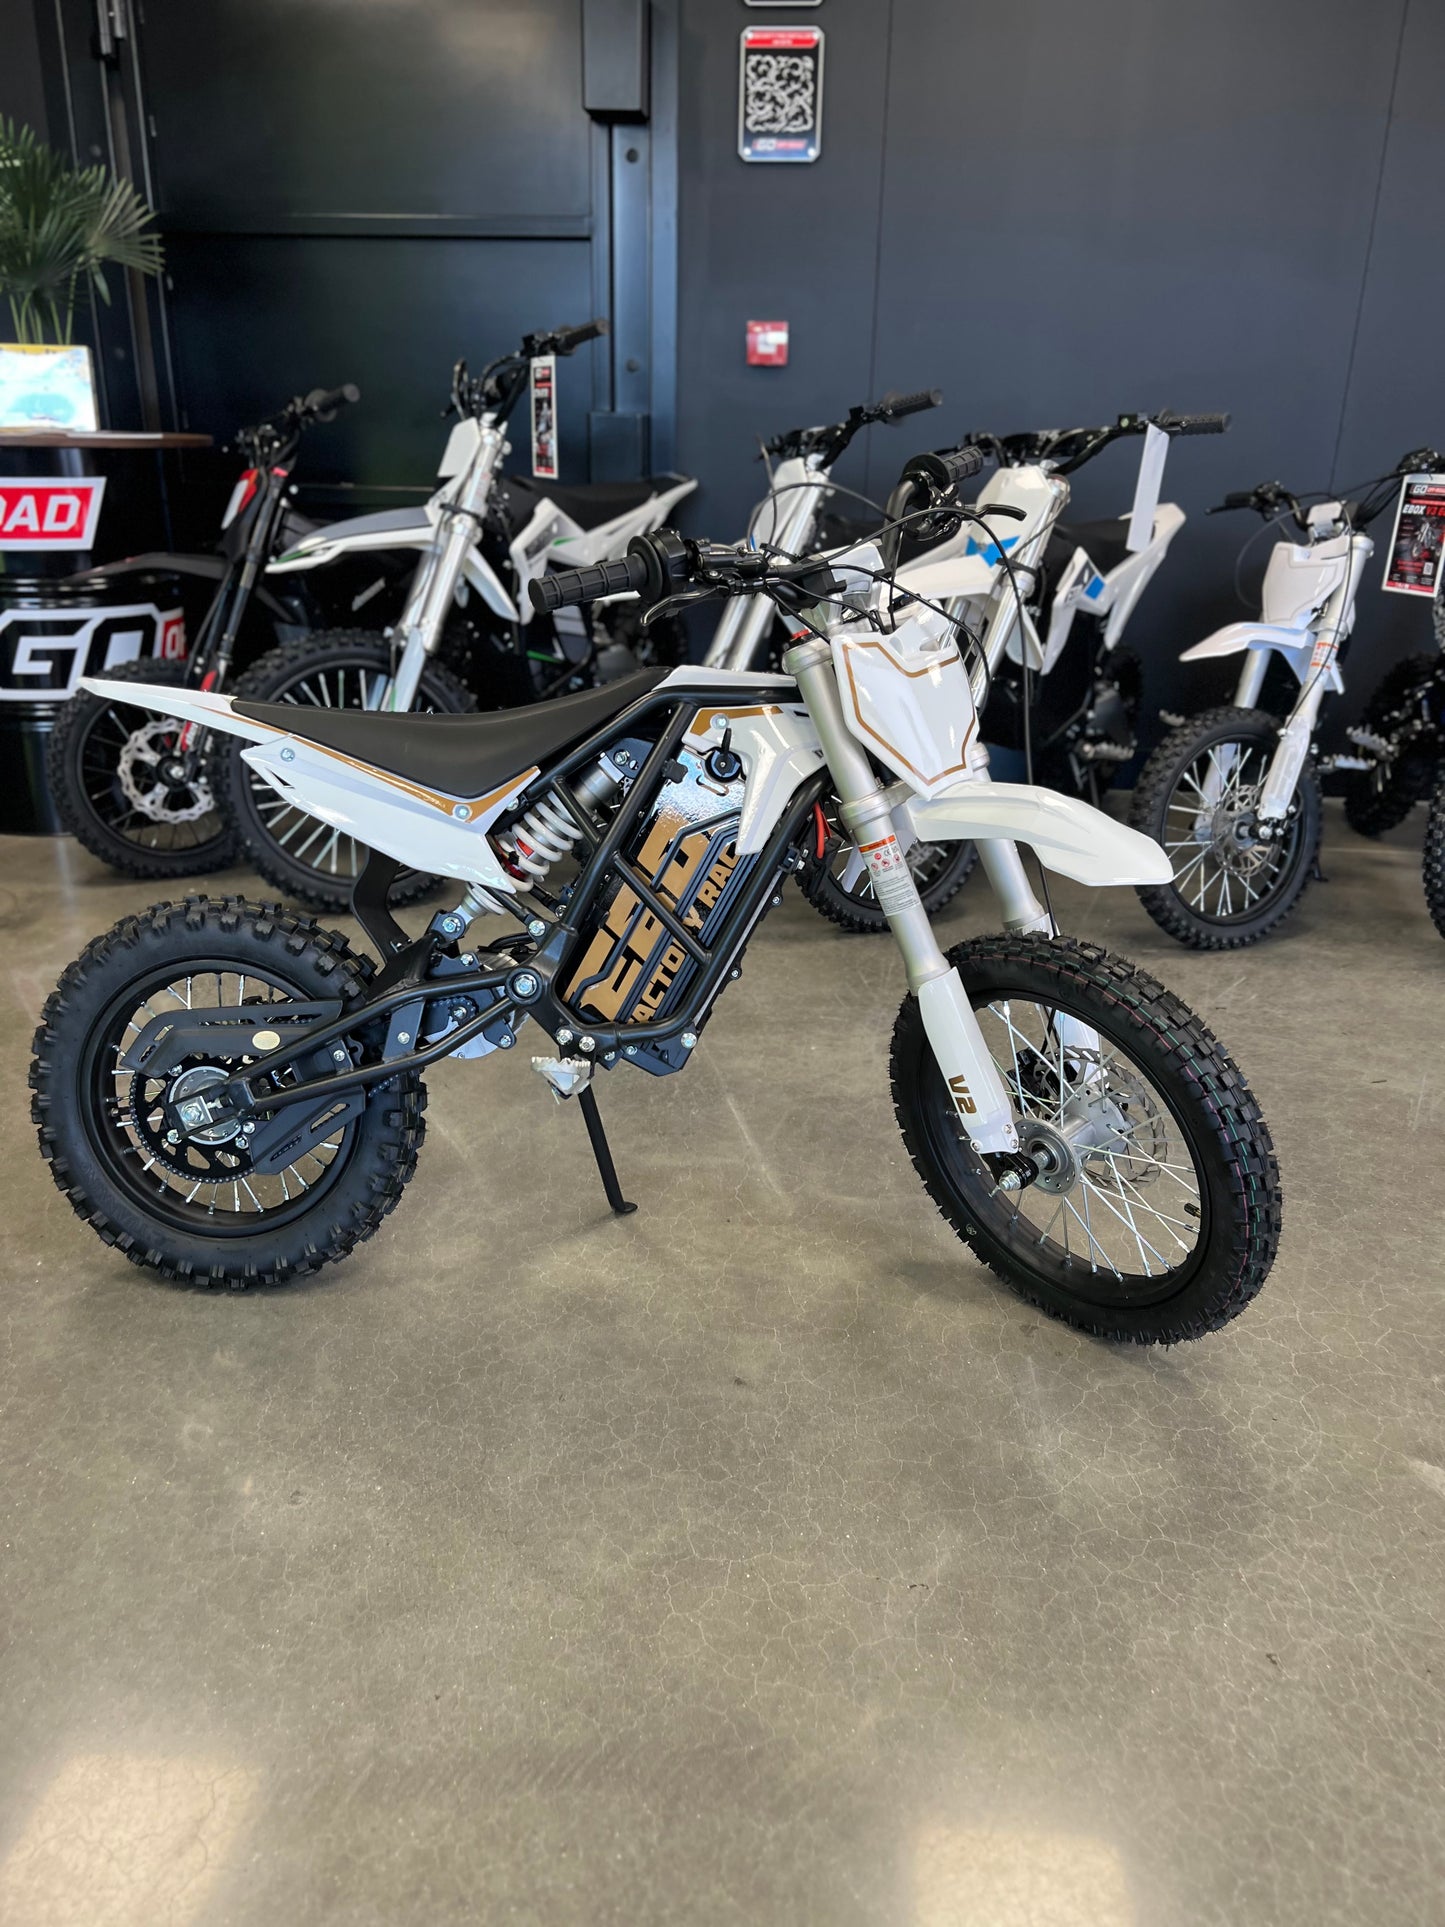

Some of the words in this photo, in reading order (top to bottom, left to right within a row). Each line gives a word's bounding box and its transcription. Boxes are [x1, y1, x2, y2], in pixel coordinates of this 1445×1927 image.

[0, 494, 81, 532] AD
[1402, 504, 1426, 515] EBOX
[948, 1074, 977, 1114] V2
